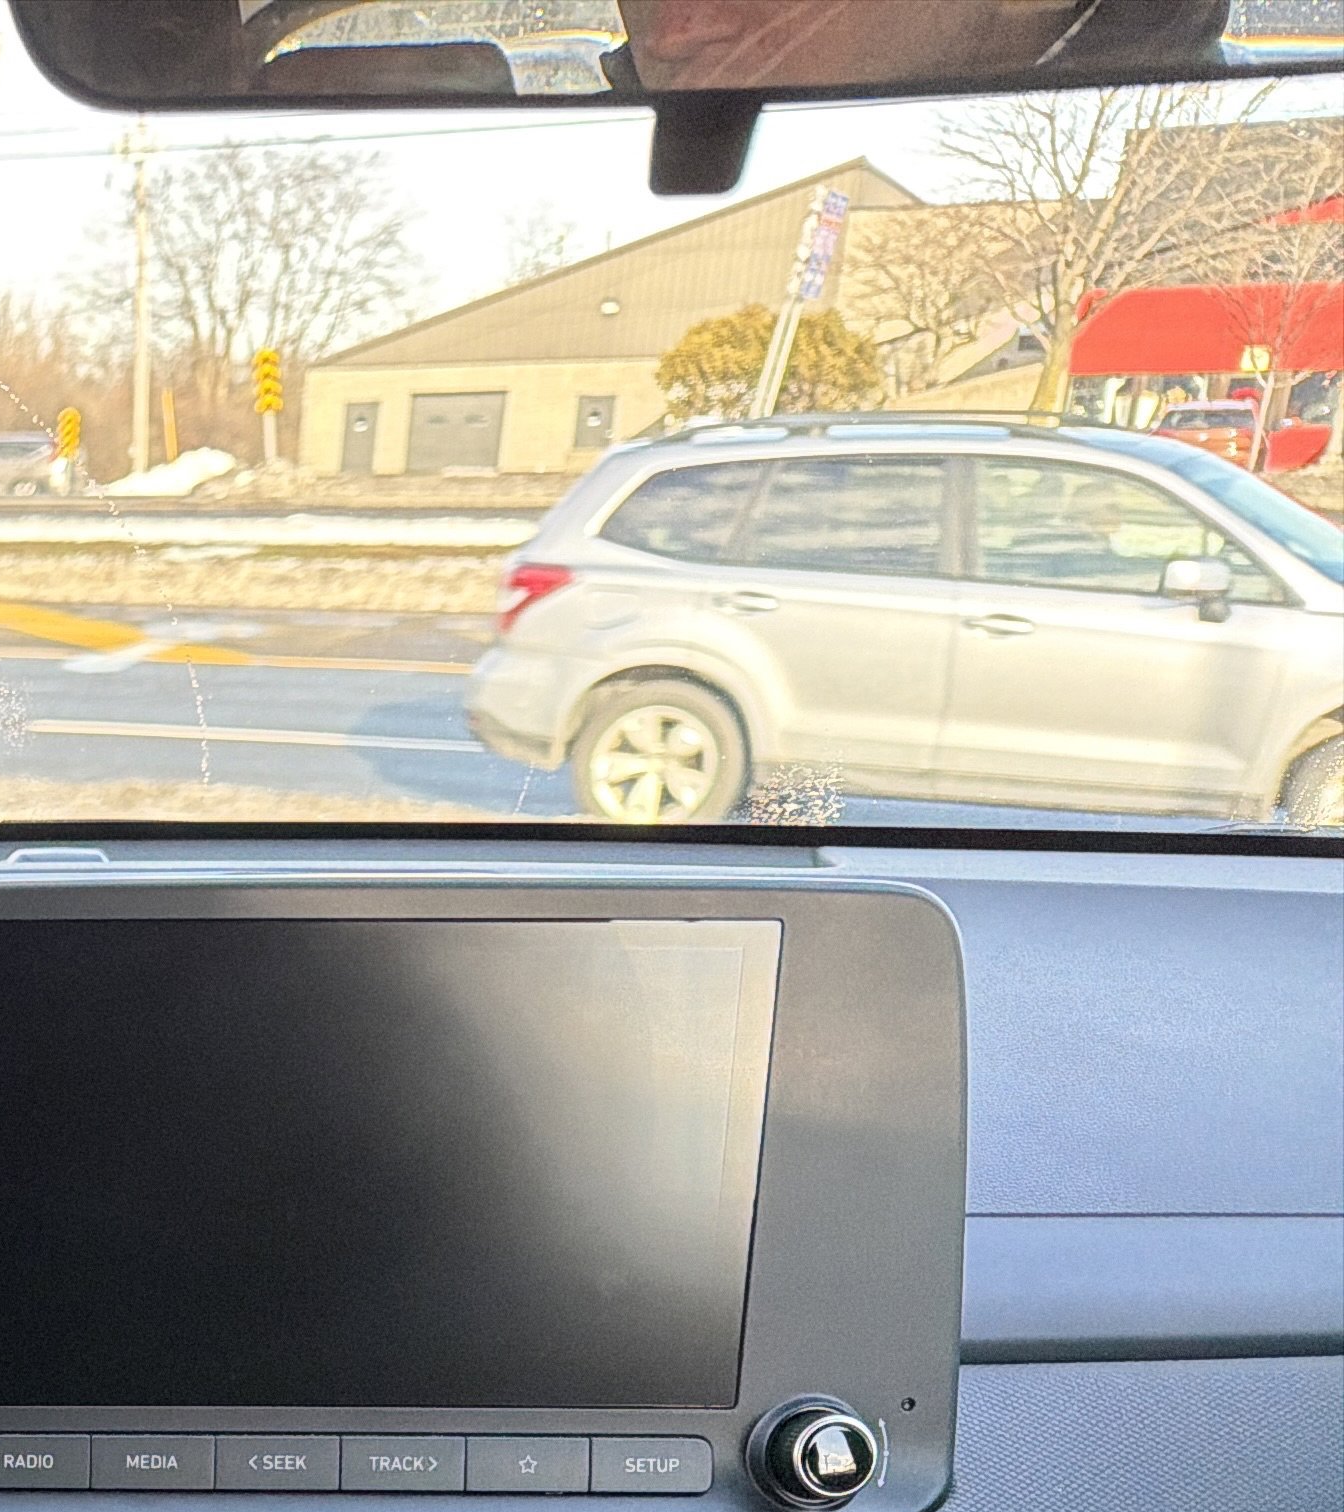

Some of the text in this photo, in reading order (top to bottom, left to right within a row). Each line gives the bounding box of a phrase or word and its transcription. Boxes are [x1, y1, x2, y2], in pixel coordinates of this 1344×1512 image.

[3, 1454, 54, 1470] RADIO
[126, 1454, 178, 1470] MEDIA
[625, 1457, 680, 1473] SETUP
